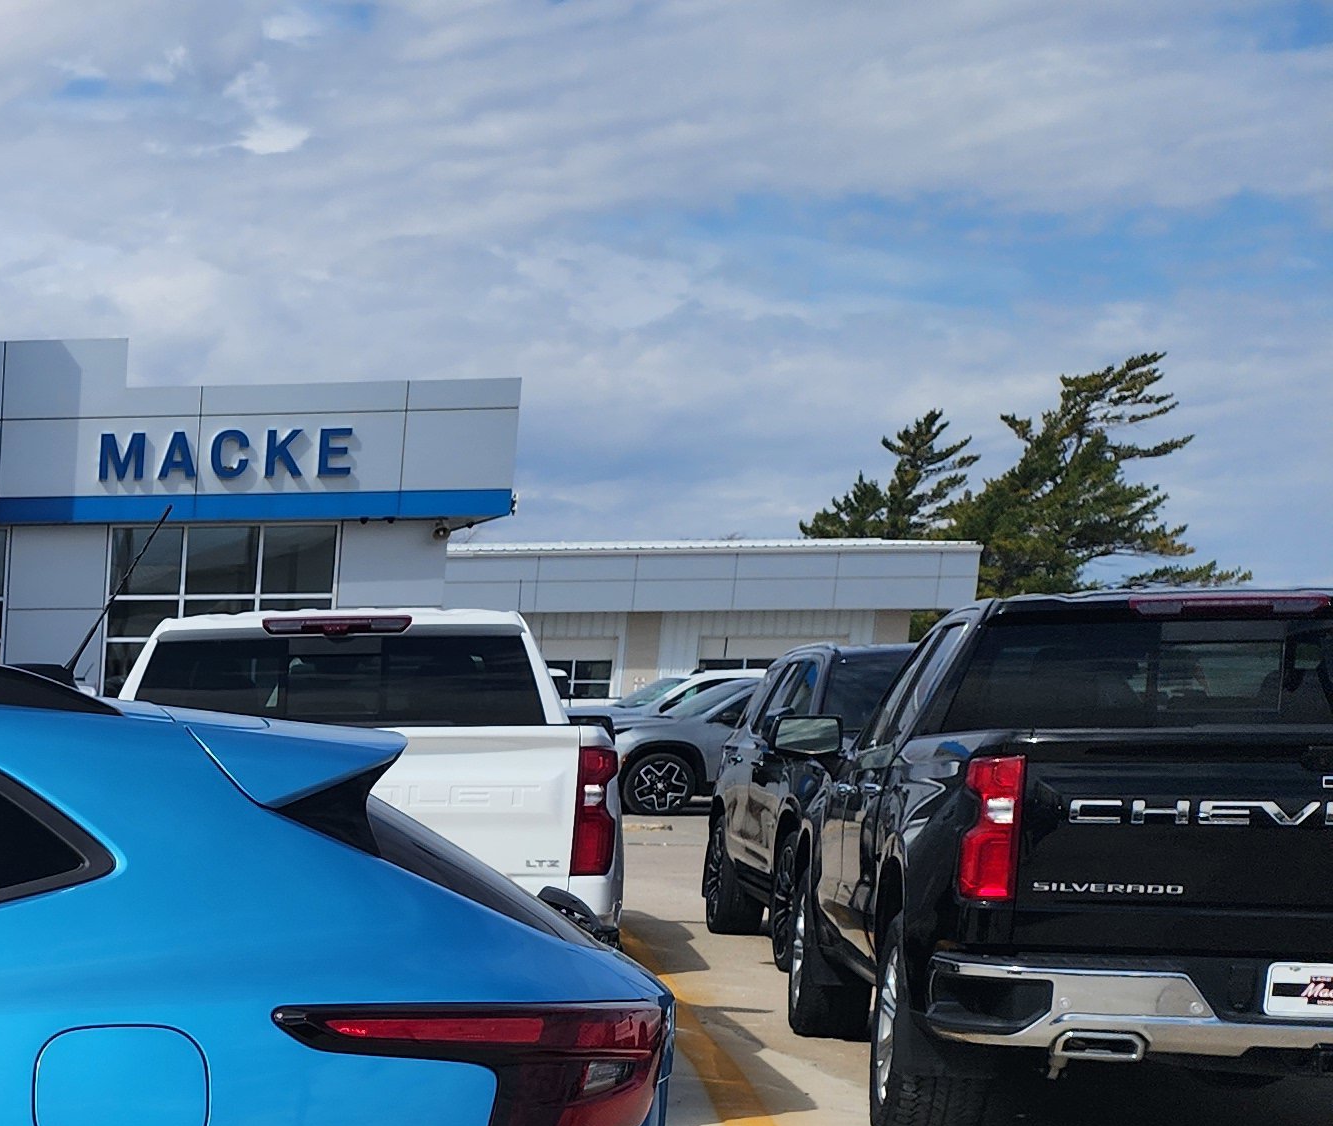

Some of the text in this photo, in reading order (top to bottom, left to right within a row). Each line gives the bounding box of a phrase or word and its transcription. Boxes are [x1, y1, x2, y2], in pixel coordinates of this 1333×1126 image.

[98, 427, 353, 482] MACKE
[1068, 800, 1333, 826] CHEV
[525, 859, 561, 868] LTZ
[1032, 881, 1184, 895] SILVERADO
